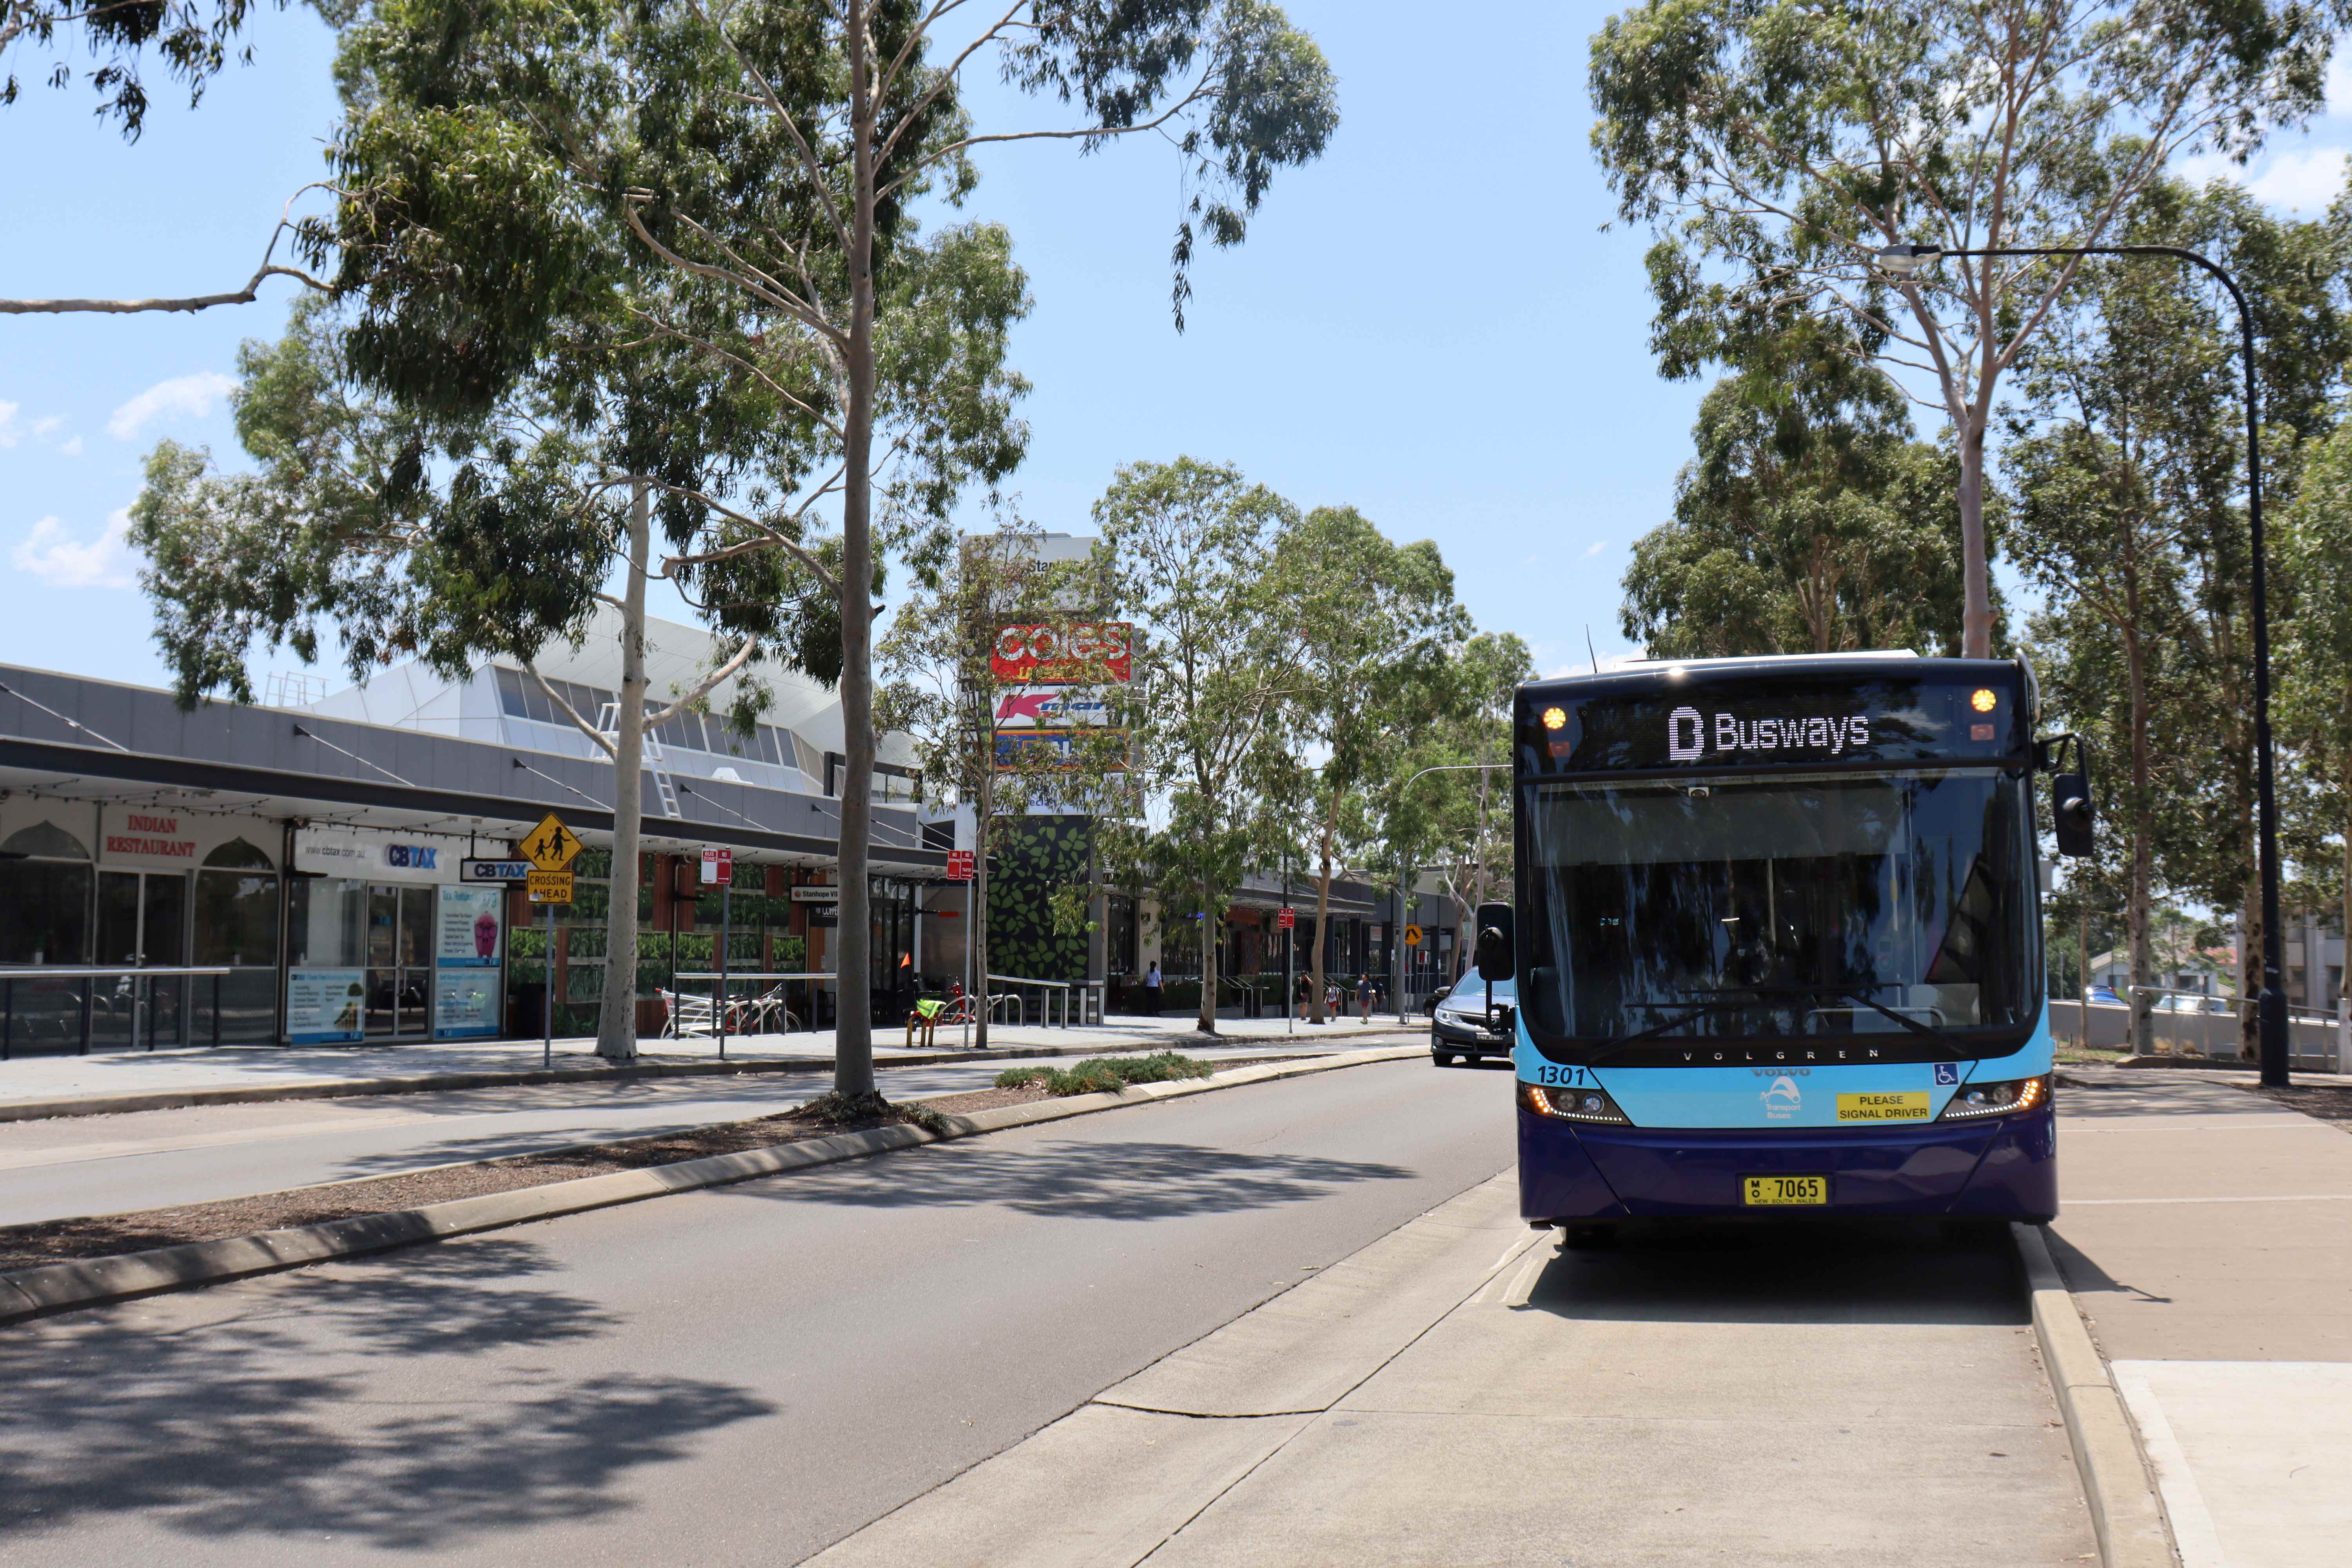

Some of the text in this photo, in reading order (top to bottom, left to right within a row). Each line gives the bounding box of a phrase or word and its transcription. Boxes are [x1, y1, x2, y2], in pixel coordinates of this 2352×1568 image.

[1715, 713, 1869, 754] Busways
[127, 815, 177, 833] INDIAN
[106, 836, 195, 857] RESTAURANT
[305, 846, 365, 858] www.cbtax.com.au
[530, 876, 570, 886] CROSSING
[533, 889, 567, 898] AHEAD
[1684, 1049, 1878, 1060] VOLGREN
[1538, 1065, 1584, 1085] 1301
[1750, 1067, 1811, 1077] VOLVO
[1860, 1096, 1904, 1105] PLEASE
[1840, 1108, 1927, 1118] SIGNAL DRIVER
[1775, 1180, 1818, 1198] 7065
